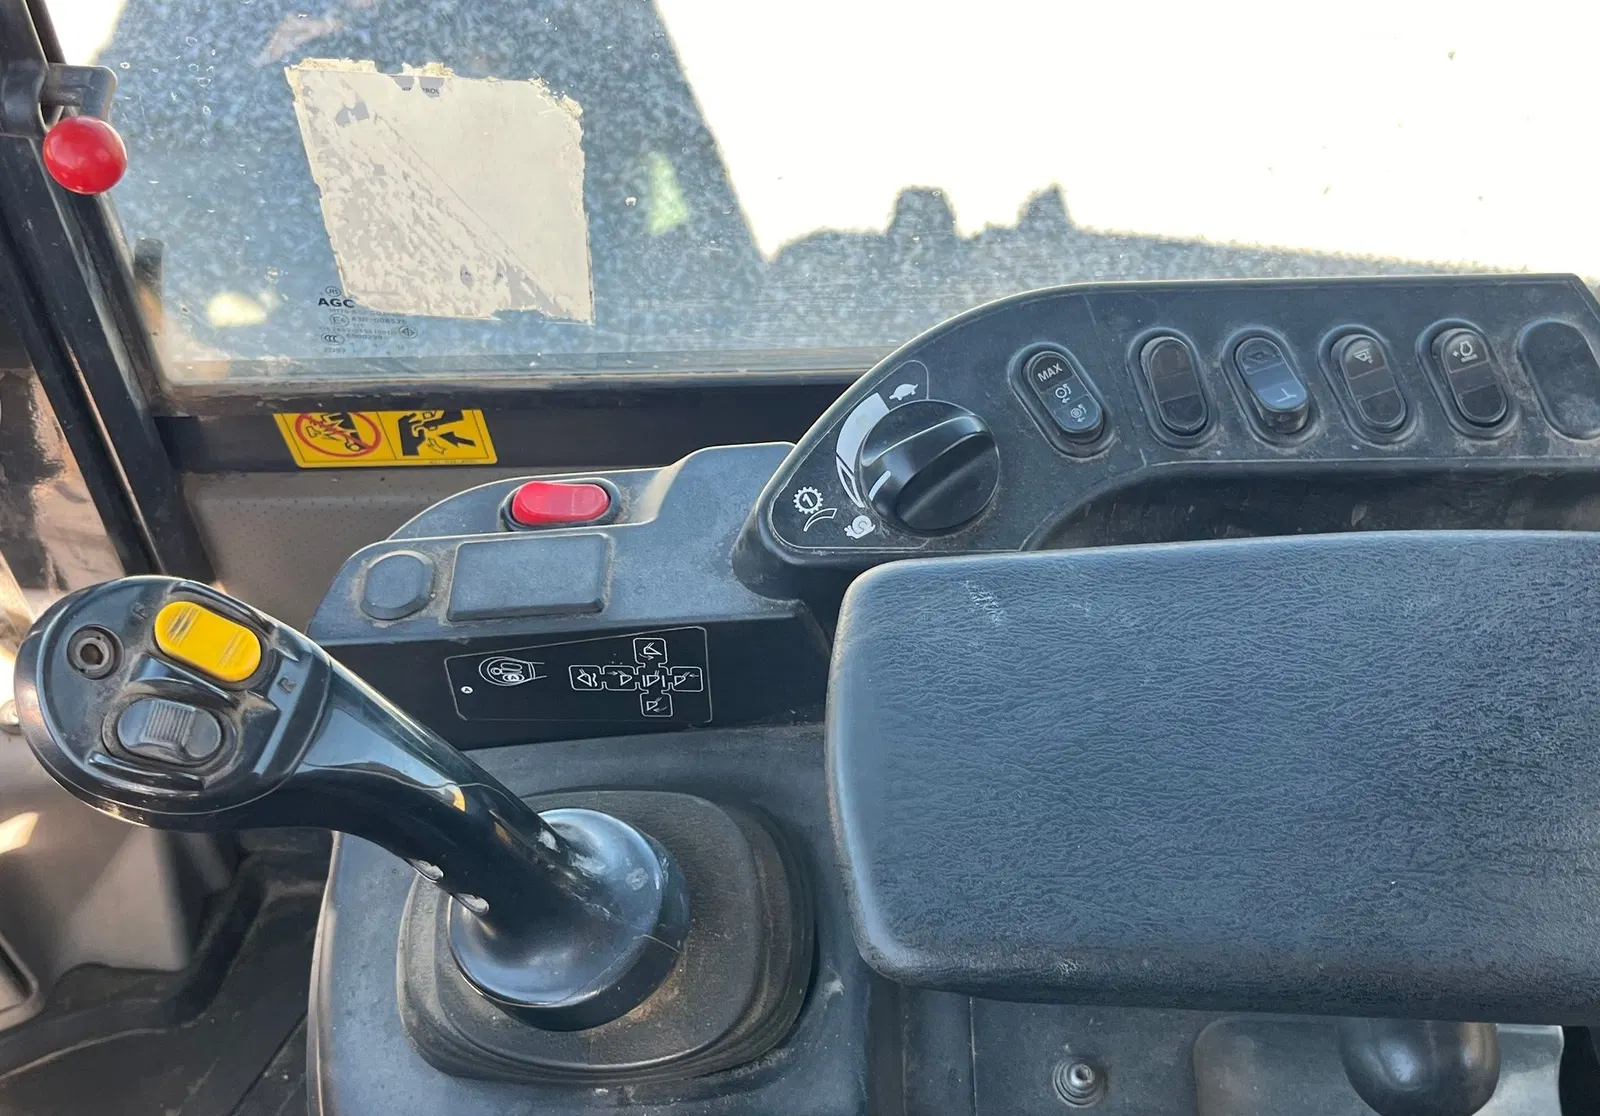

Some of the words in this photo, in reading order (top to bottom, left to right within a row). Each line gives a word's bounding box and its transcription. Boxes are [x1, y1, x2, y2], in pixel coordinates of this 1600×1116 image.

[318, 298, 355, 308] AGC
[1037, 363, 1063, 382] MAX
[802, 493, 814, 507] 1
[277, 675, 296, 694] R
